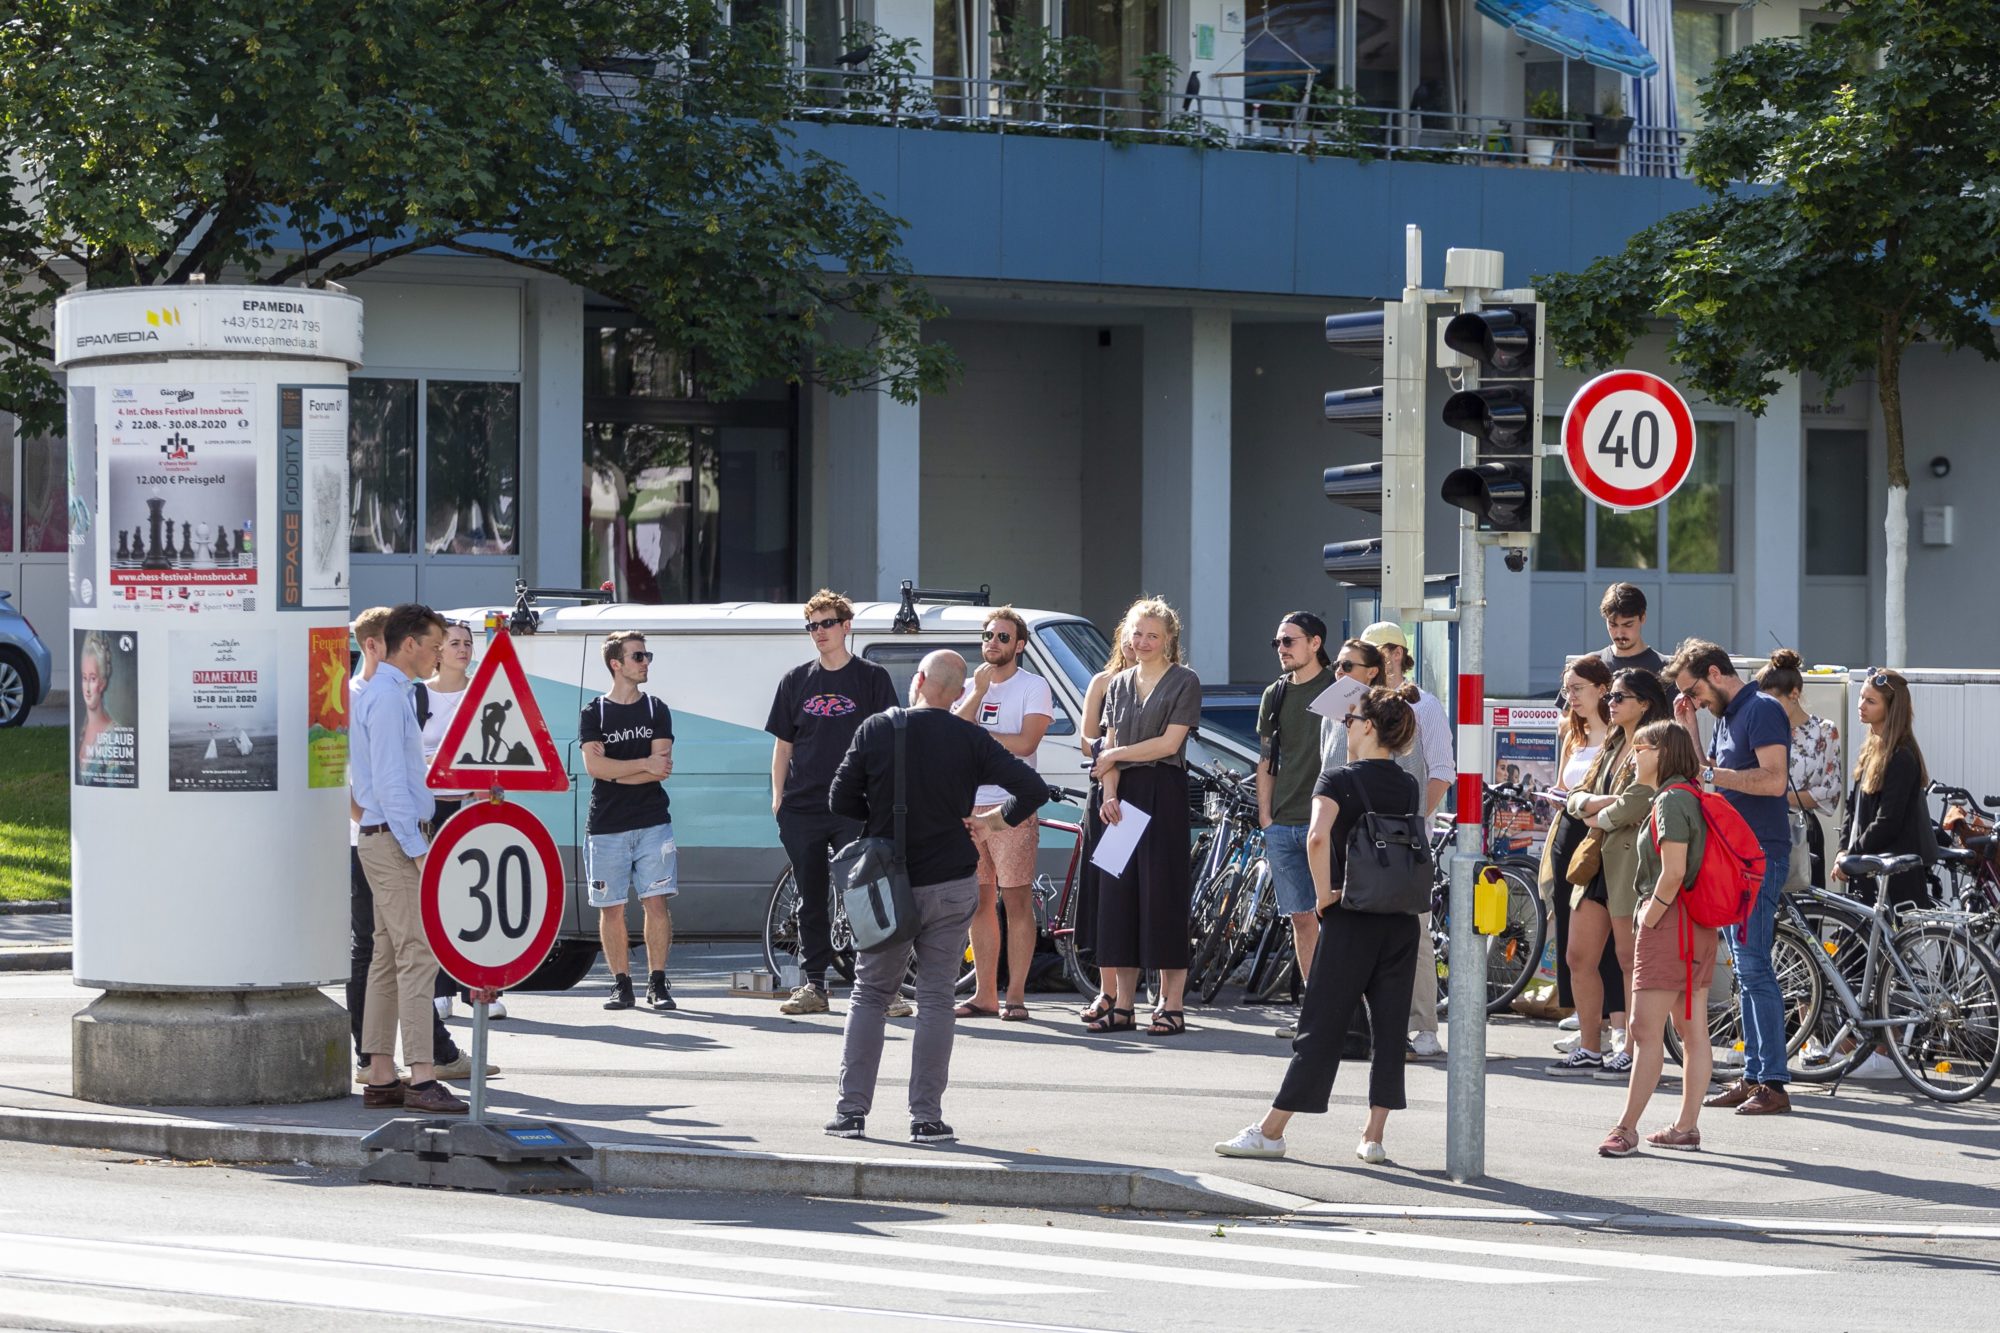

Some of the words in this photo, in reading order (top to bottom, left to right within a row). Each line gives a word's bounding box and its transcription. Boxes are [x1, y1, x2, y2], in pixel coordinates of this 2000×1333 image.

[242, 300, 305, 314] EPAMEDIA
[221, 316, 299, 330] +43/512/274
[301, 320, 321, 332] 795
[76, 331, 159, 347] EPAMEDIA
[223, 334, 319, 350] www.epamedia.at
[165, 407, 198, 415] Festival
[200, 407, 243, 415] Innsbruck
[309, 400, 336, 411] Forum
[132, 421, 161, 429] 22.08.
[168, 420, 227, 429] 30.08.2020
[1598, 409, 1660, 470] 40
[285, 435, 299, 506] ODDITY
[136, 476, 168, 485] 12.000
[169, 476, 176, 485] €
[177, 475, 226, 487] Preisgeld
[285, 513, 299, 604] SPACE
[117, 573, 248, 581] www.chess-festival-innsbruck.at
[193, 671, 257, 683] DIAMETRALE
[235, 695, 258, 703] 2020
[97, 733, 135, 746] URLAUB
[85, 745, 95, 757] IM
[95, 746, 135, 759] MUSEUM
[457, 844, 532, 943] 30
